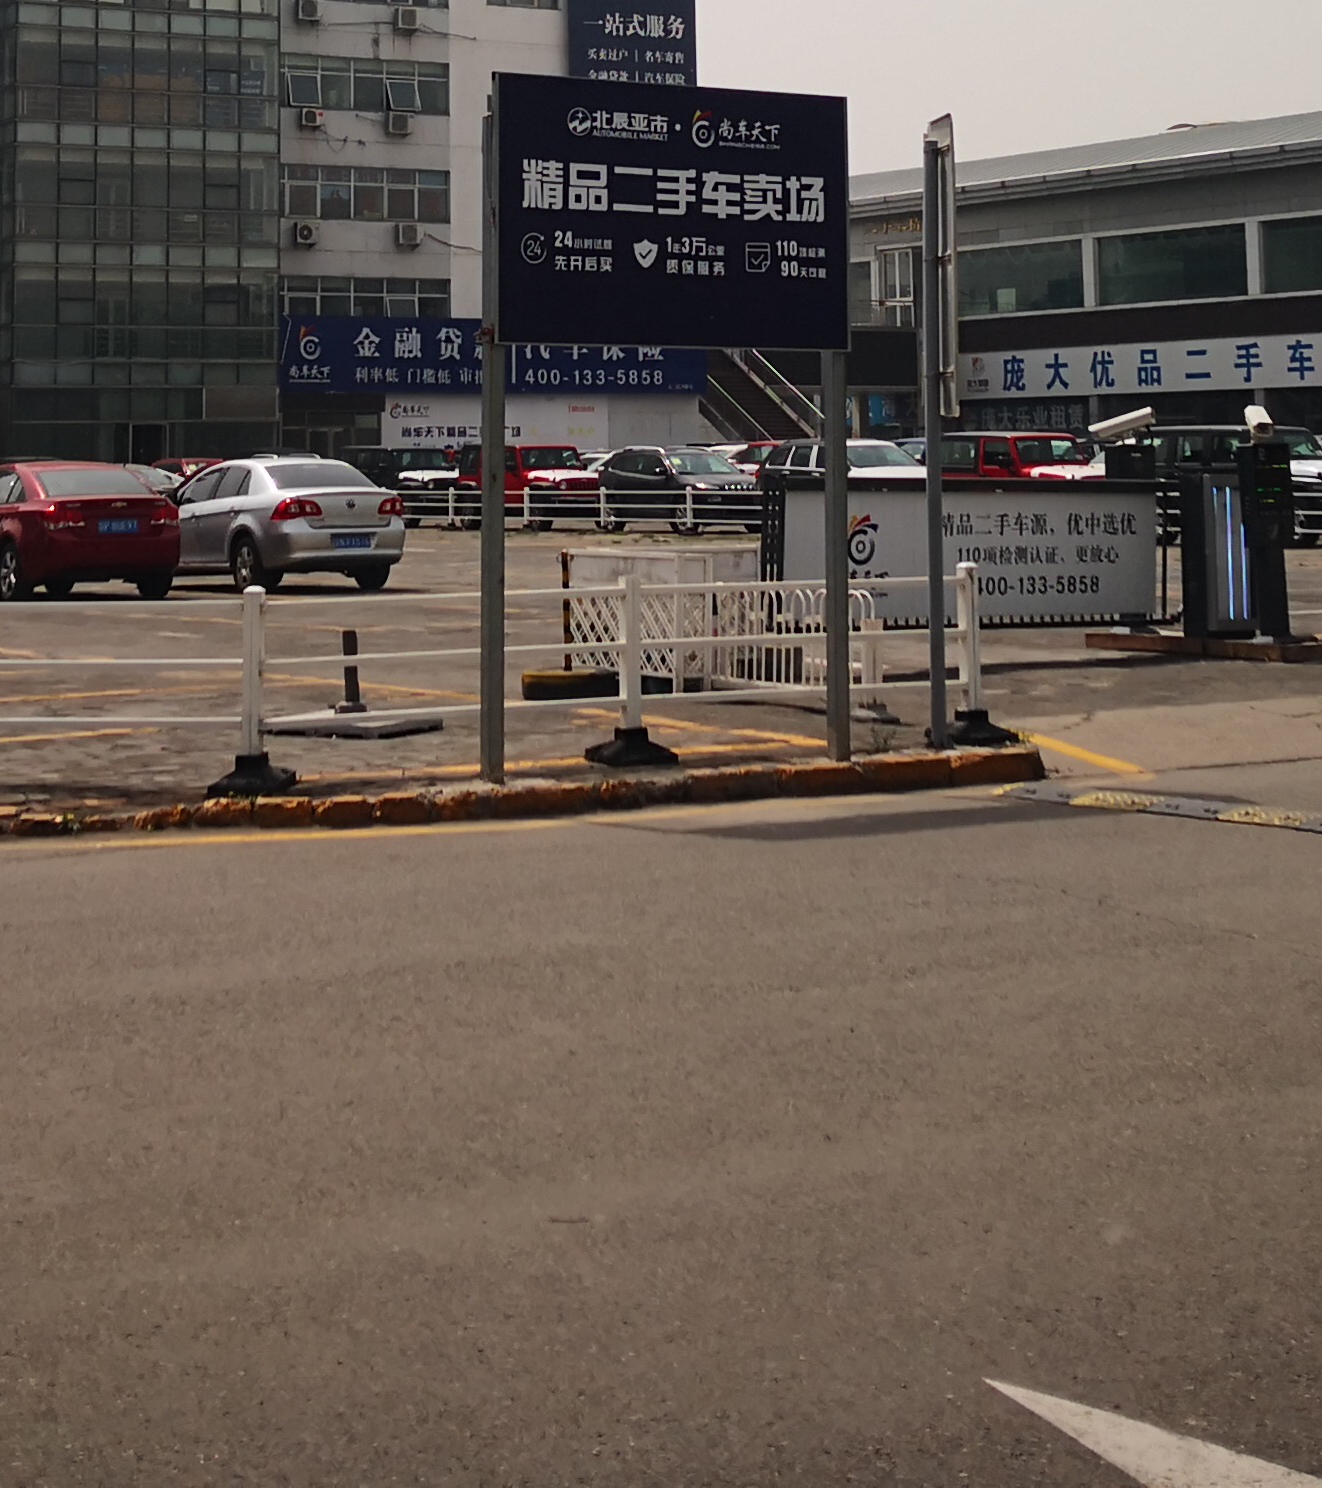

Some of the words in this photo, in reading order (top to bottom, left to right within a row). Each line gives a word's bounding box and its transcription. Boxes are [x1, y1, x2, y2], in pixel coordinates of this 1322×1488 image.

[582, 11, 686, 40] 一站式服务
[591, 109, 669, 133] 北辰亚市
[717, 117, 781, 143] 尚车天下
[522, 158, 826, 223] 精品二手车卖场
[554, 255, 613, 273] 先开后买
[524, 368, 664, 386] 400-133-5858
